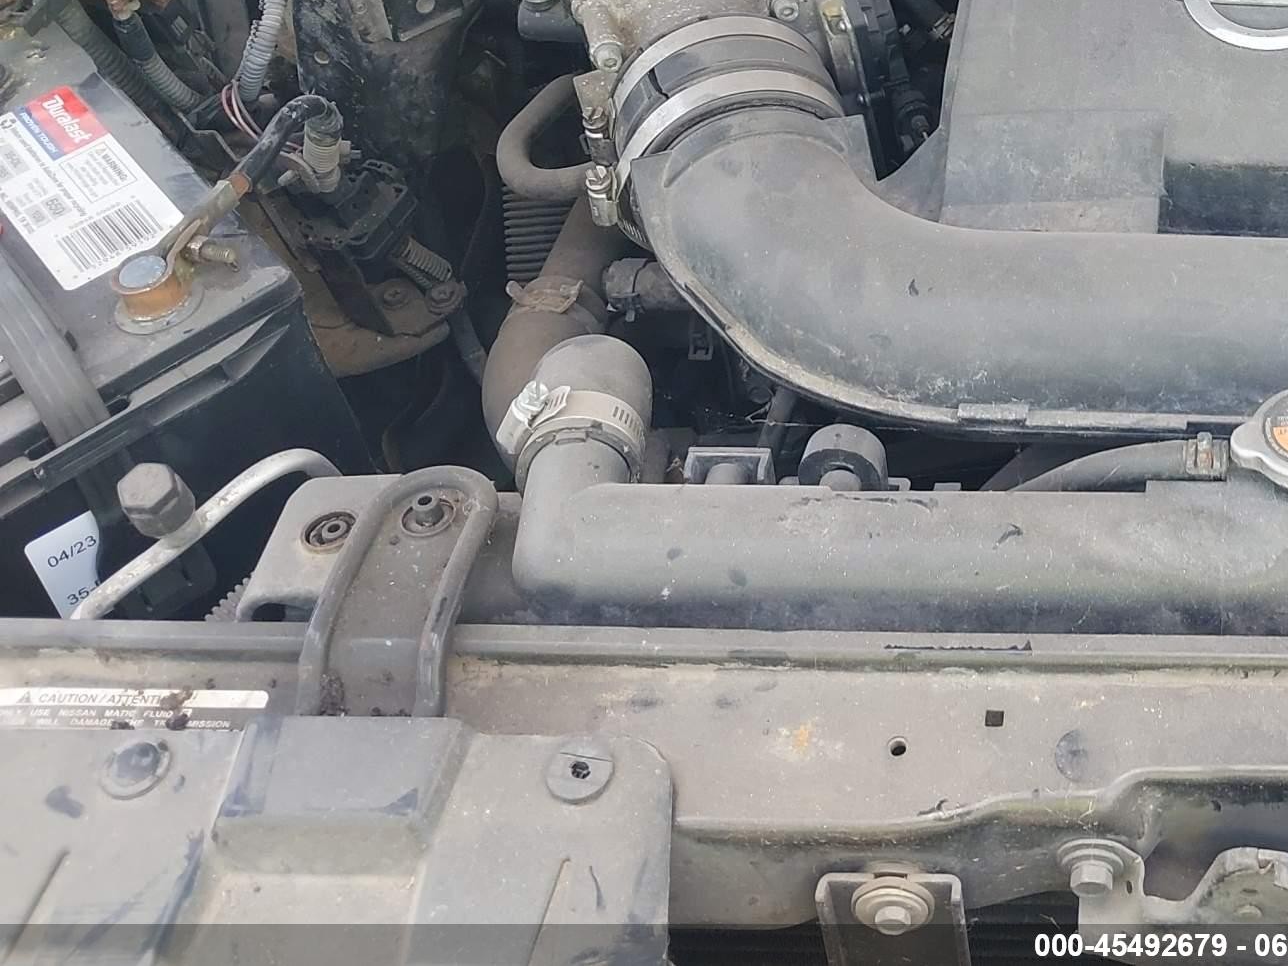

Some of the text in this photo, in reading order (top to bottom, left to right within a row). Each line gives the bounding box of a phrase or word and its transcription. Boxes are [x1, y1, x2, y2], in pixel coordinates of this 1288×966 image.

[42, 94, 93, 143] Duralast
[47, 535, 97, 568] 04/23
[39, 693, 97, 703] CAUTION
[31, 708, 51, 716] USE
[58, 709, 97, 717] NISSAN
